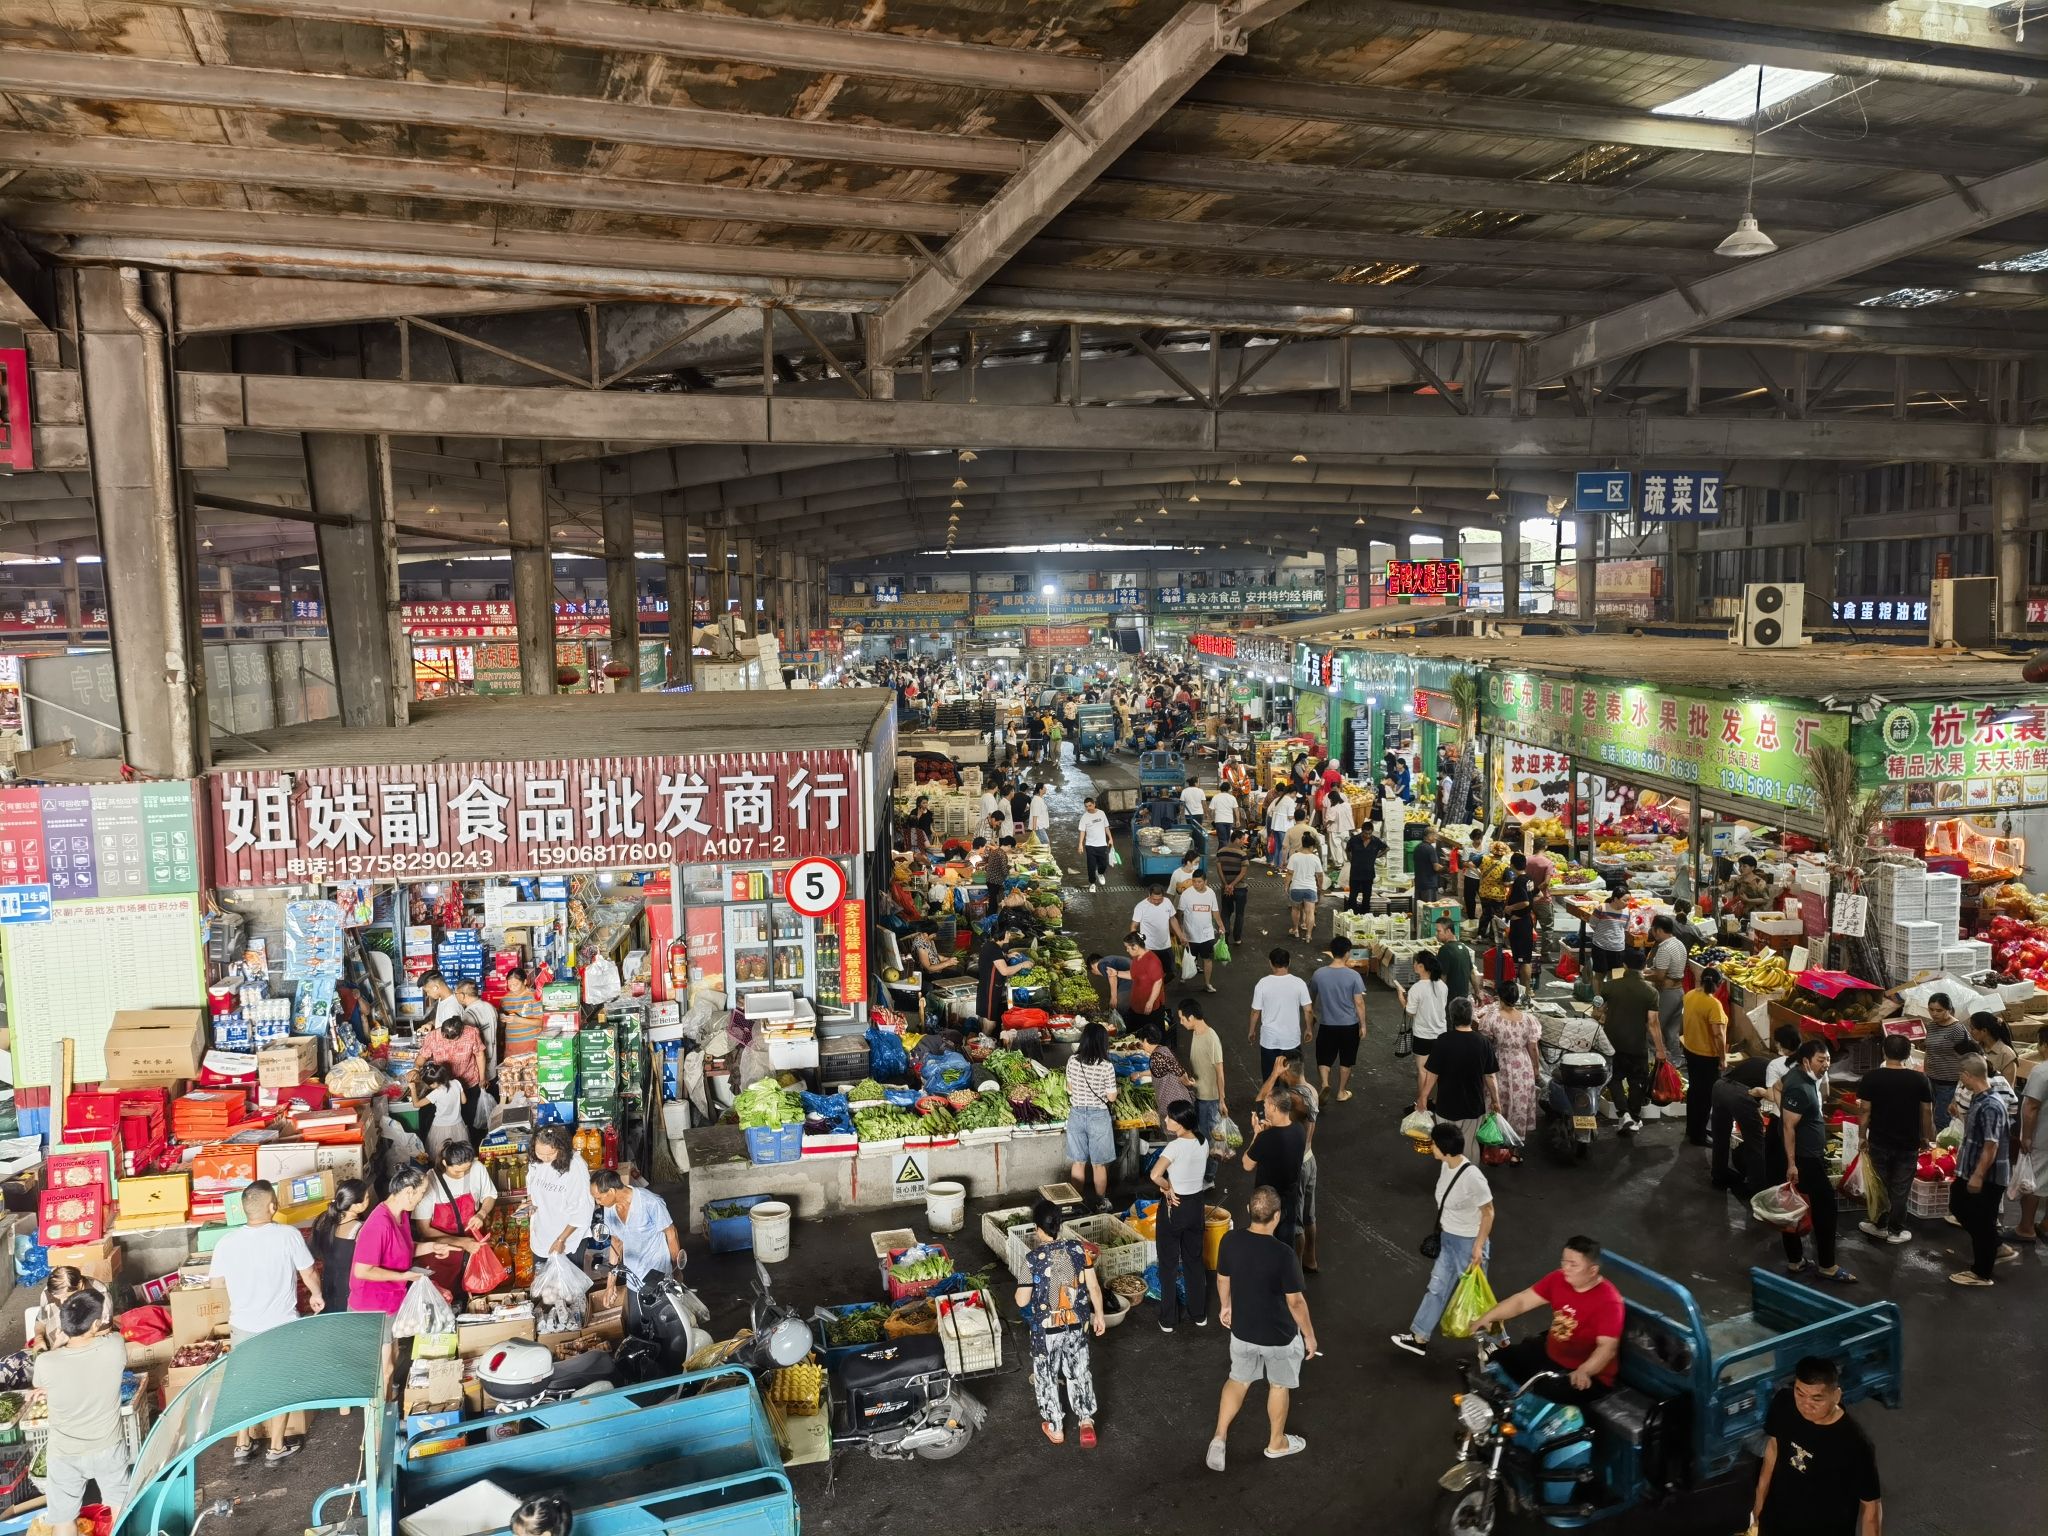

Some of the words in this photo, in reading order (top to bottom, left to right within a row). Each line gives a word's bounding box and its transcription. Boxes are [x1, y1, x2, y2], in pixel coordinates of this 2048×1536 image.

[1583, 480, 1624, 502] 一区
[1643, 475, 1720, 516] 蔬菜区
[297, 601, 318, 610] 生姜
[297, 609, 318, 618] 大蒜
[402, 604, 511, 617] 嘉伟冷冻食品批发
[1501, 678, 1822, 755] 杭东襄阳老秦水果批发总汇
[1716, 747, 1761, 771] 订货配送
[1888, 752, 1965, 780] 精品水果
[1976, 748, 2048, 773] 天天新鲜
[222, 767, 849, 854] 姐妹副食品批发商行
[287, 849, 493, 876] 电话:13758290243
[528, 840, 672, 865] 15906817600
[21, 891, 49, 903] 卫生间
[805, 872, 825, 900] 5
[53, 901, 189, 918] 农副产品批发市场摊位积分榜
